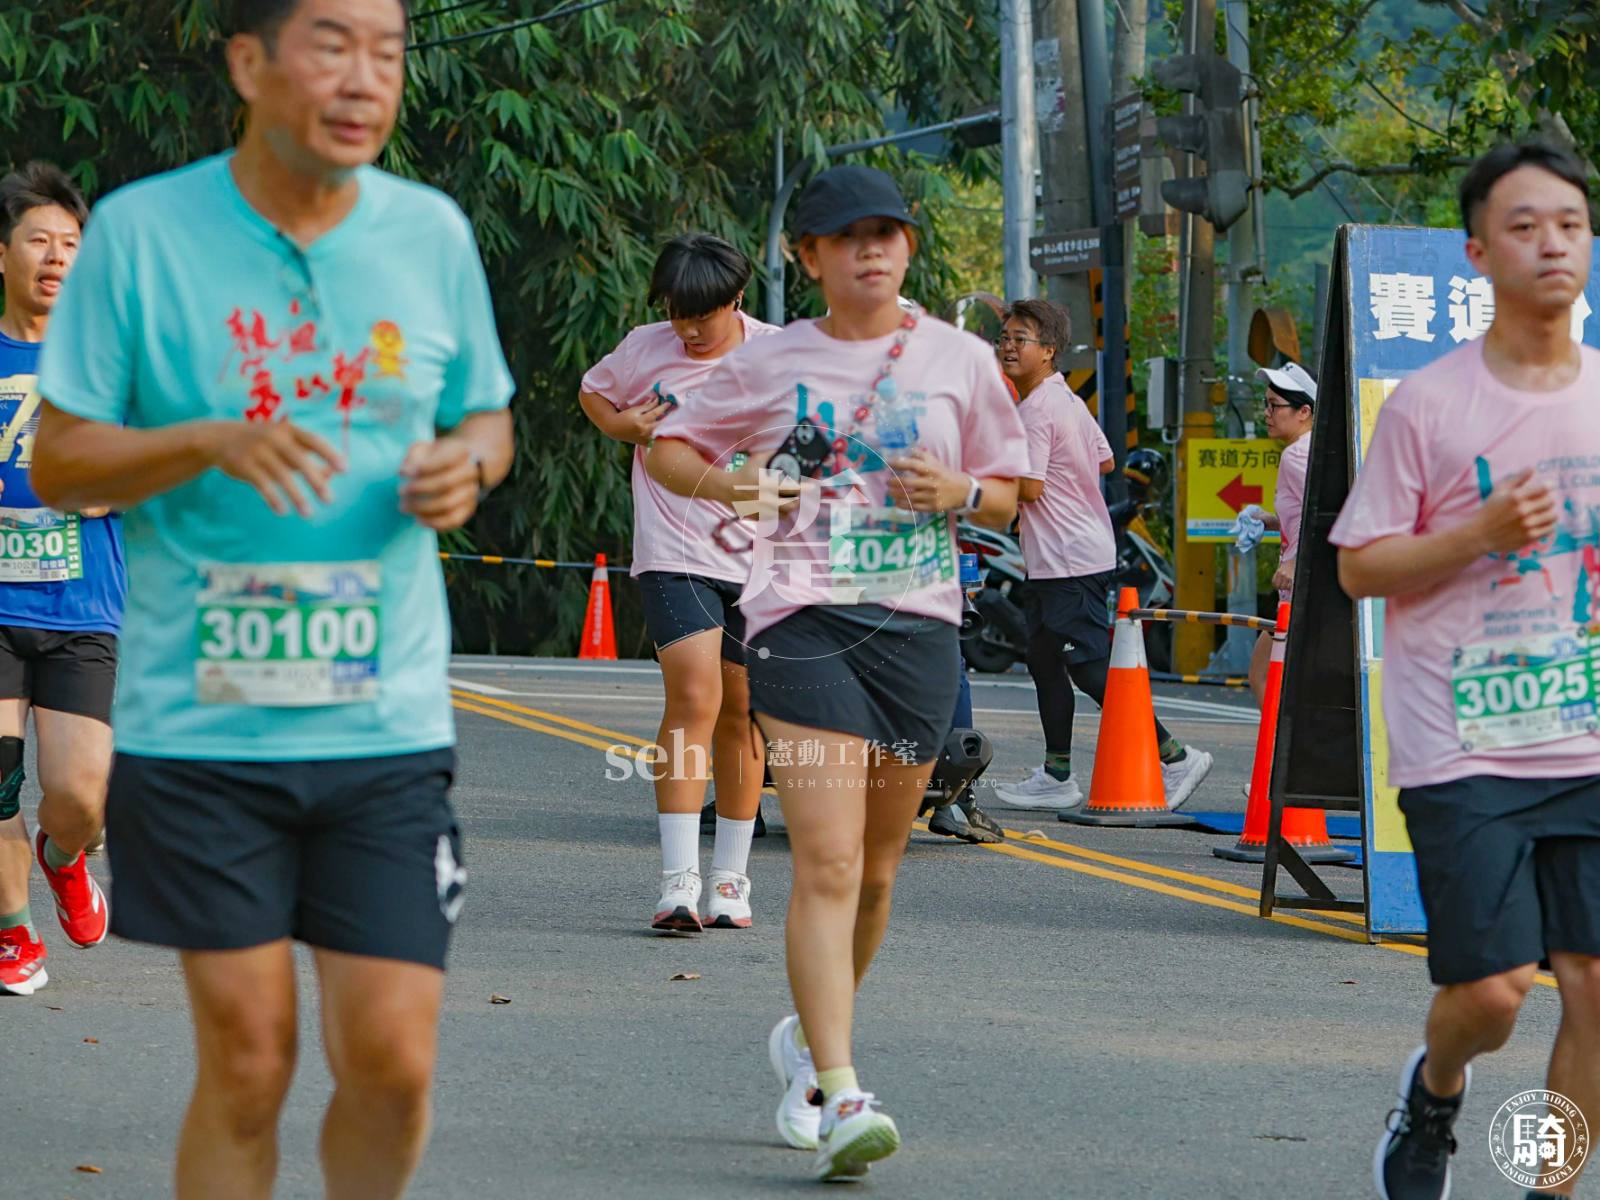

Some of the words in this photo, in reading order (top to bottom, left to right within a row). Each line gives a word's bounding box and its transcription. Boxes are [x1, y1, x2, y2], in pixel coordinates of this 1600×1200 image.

[1198, 448, 1281, 469] 賽道方向
[832, 526, 938, 572] 40429
[201, 607, 377, 660] 30100
[1457, 662, 1589, 719] 30025
